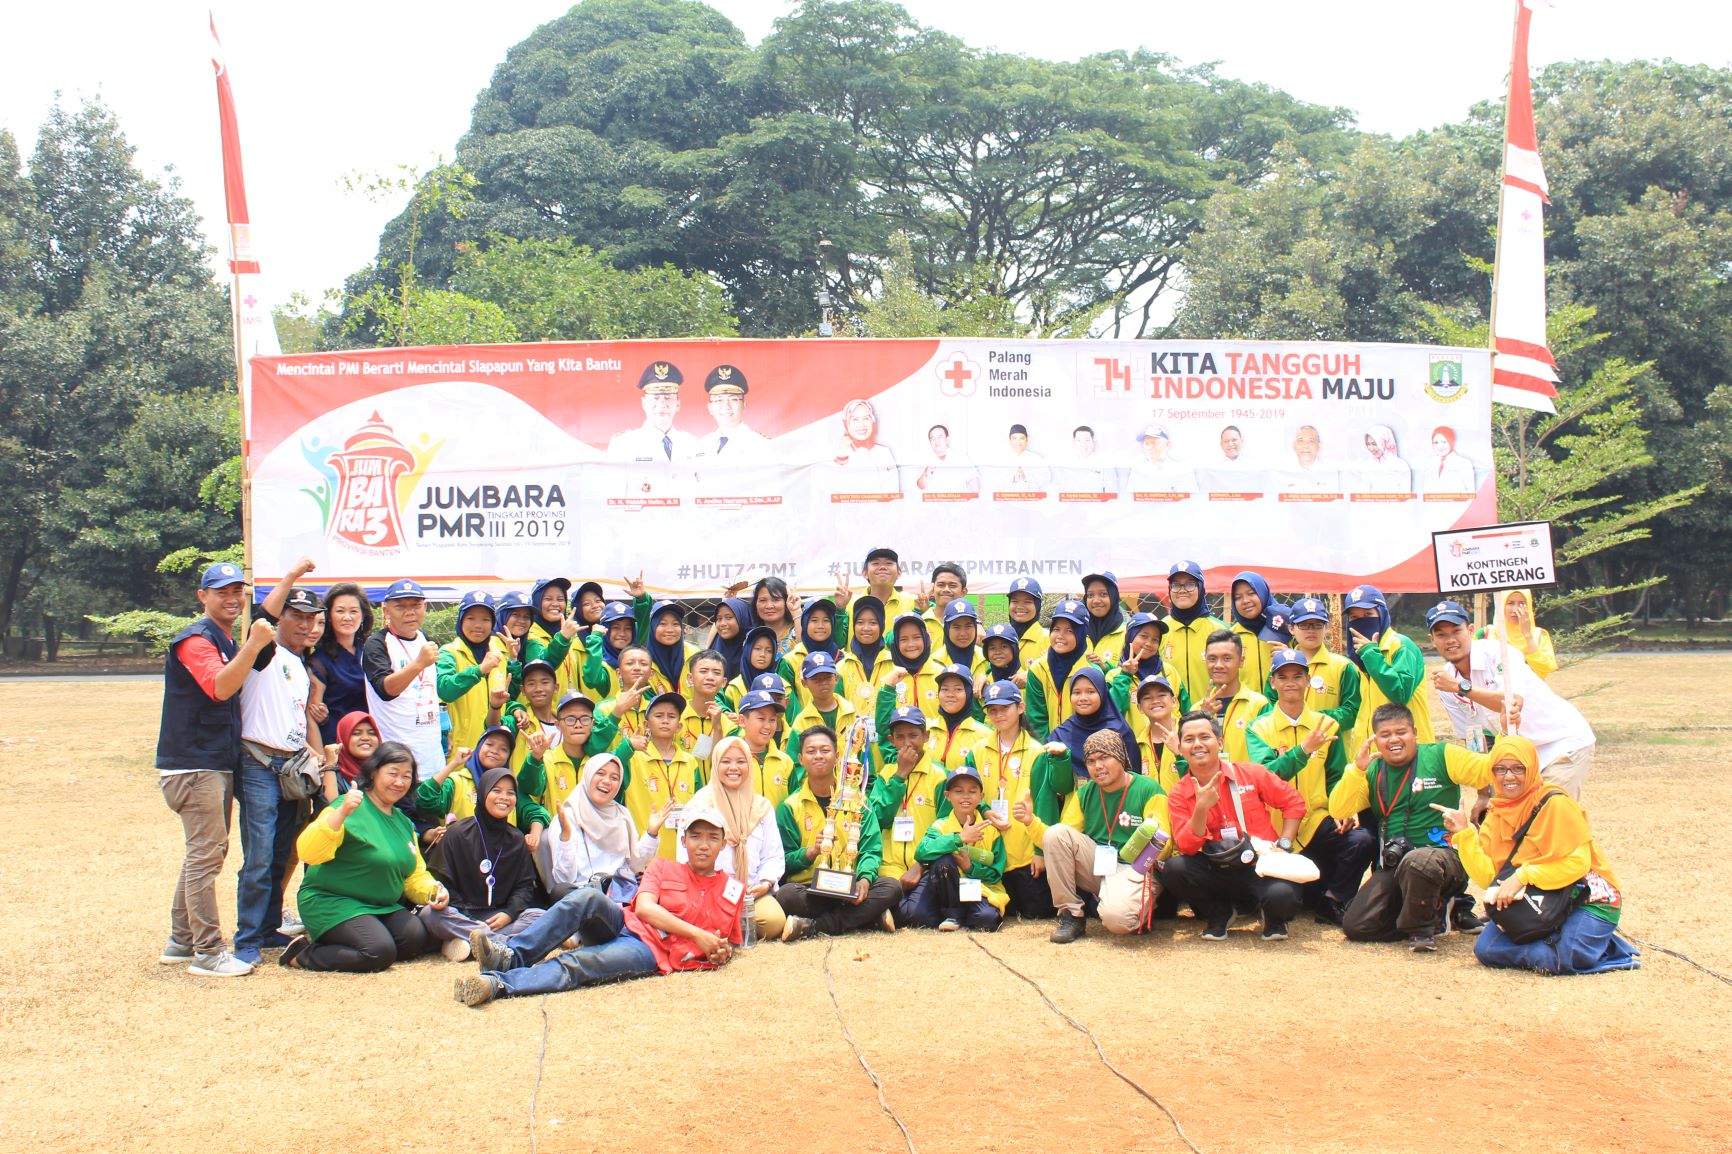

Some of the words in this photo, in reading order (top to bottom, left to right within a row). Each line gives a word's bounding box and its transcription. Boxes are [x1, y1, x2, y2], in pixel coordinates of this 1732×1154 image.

[276, 362, 335, 375] Mencintai
[338, 362, 360, 375] PMI
[363, 361, 404, 375] Berarti
[407, 360, 466, 374] Mencintai
[469, 359, 523, 375] Siapapun
[526, 358, 556, 374] Yang
[558, 358, 583, 371] Kita
[586, 357, 621, 371] Bantu
[988, 350, 1032, 366] Palang
[1151, 352, 1219, 375] KITA
[1225, 353, 1361, 376] TANGGUH
[989, 368, 1028, 381] Merah
[989, 385, 1052, 398] Indonesia
[1150, 376, 1313, 400] INDONESIA
[1322, 377, 1395, 400] MAJU
[1152, 409, 1163, 418] 17
[1167, 409, 1226, 420] September
[1230, 409, 1286, 419] 1945-2019
[418, 484, 566, 510] JUMBARA
[488, 511, 523, 519] TINGKAT
[526, 510, 566, 519] PROVINSI
[418, 512, 485, 538] PMR
[489, 520, 506, 538] III
[513, 519, 565, 538] 2019
[368, 547, 401, 557] BANTEN
[1466, 556, 1529, 570] KONTINGEN
[1450, 572, 1487, 588] KOTA
[1490, 567, 1546, 584] SERANG
